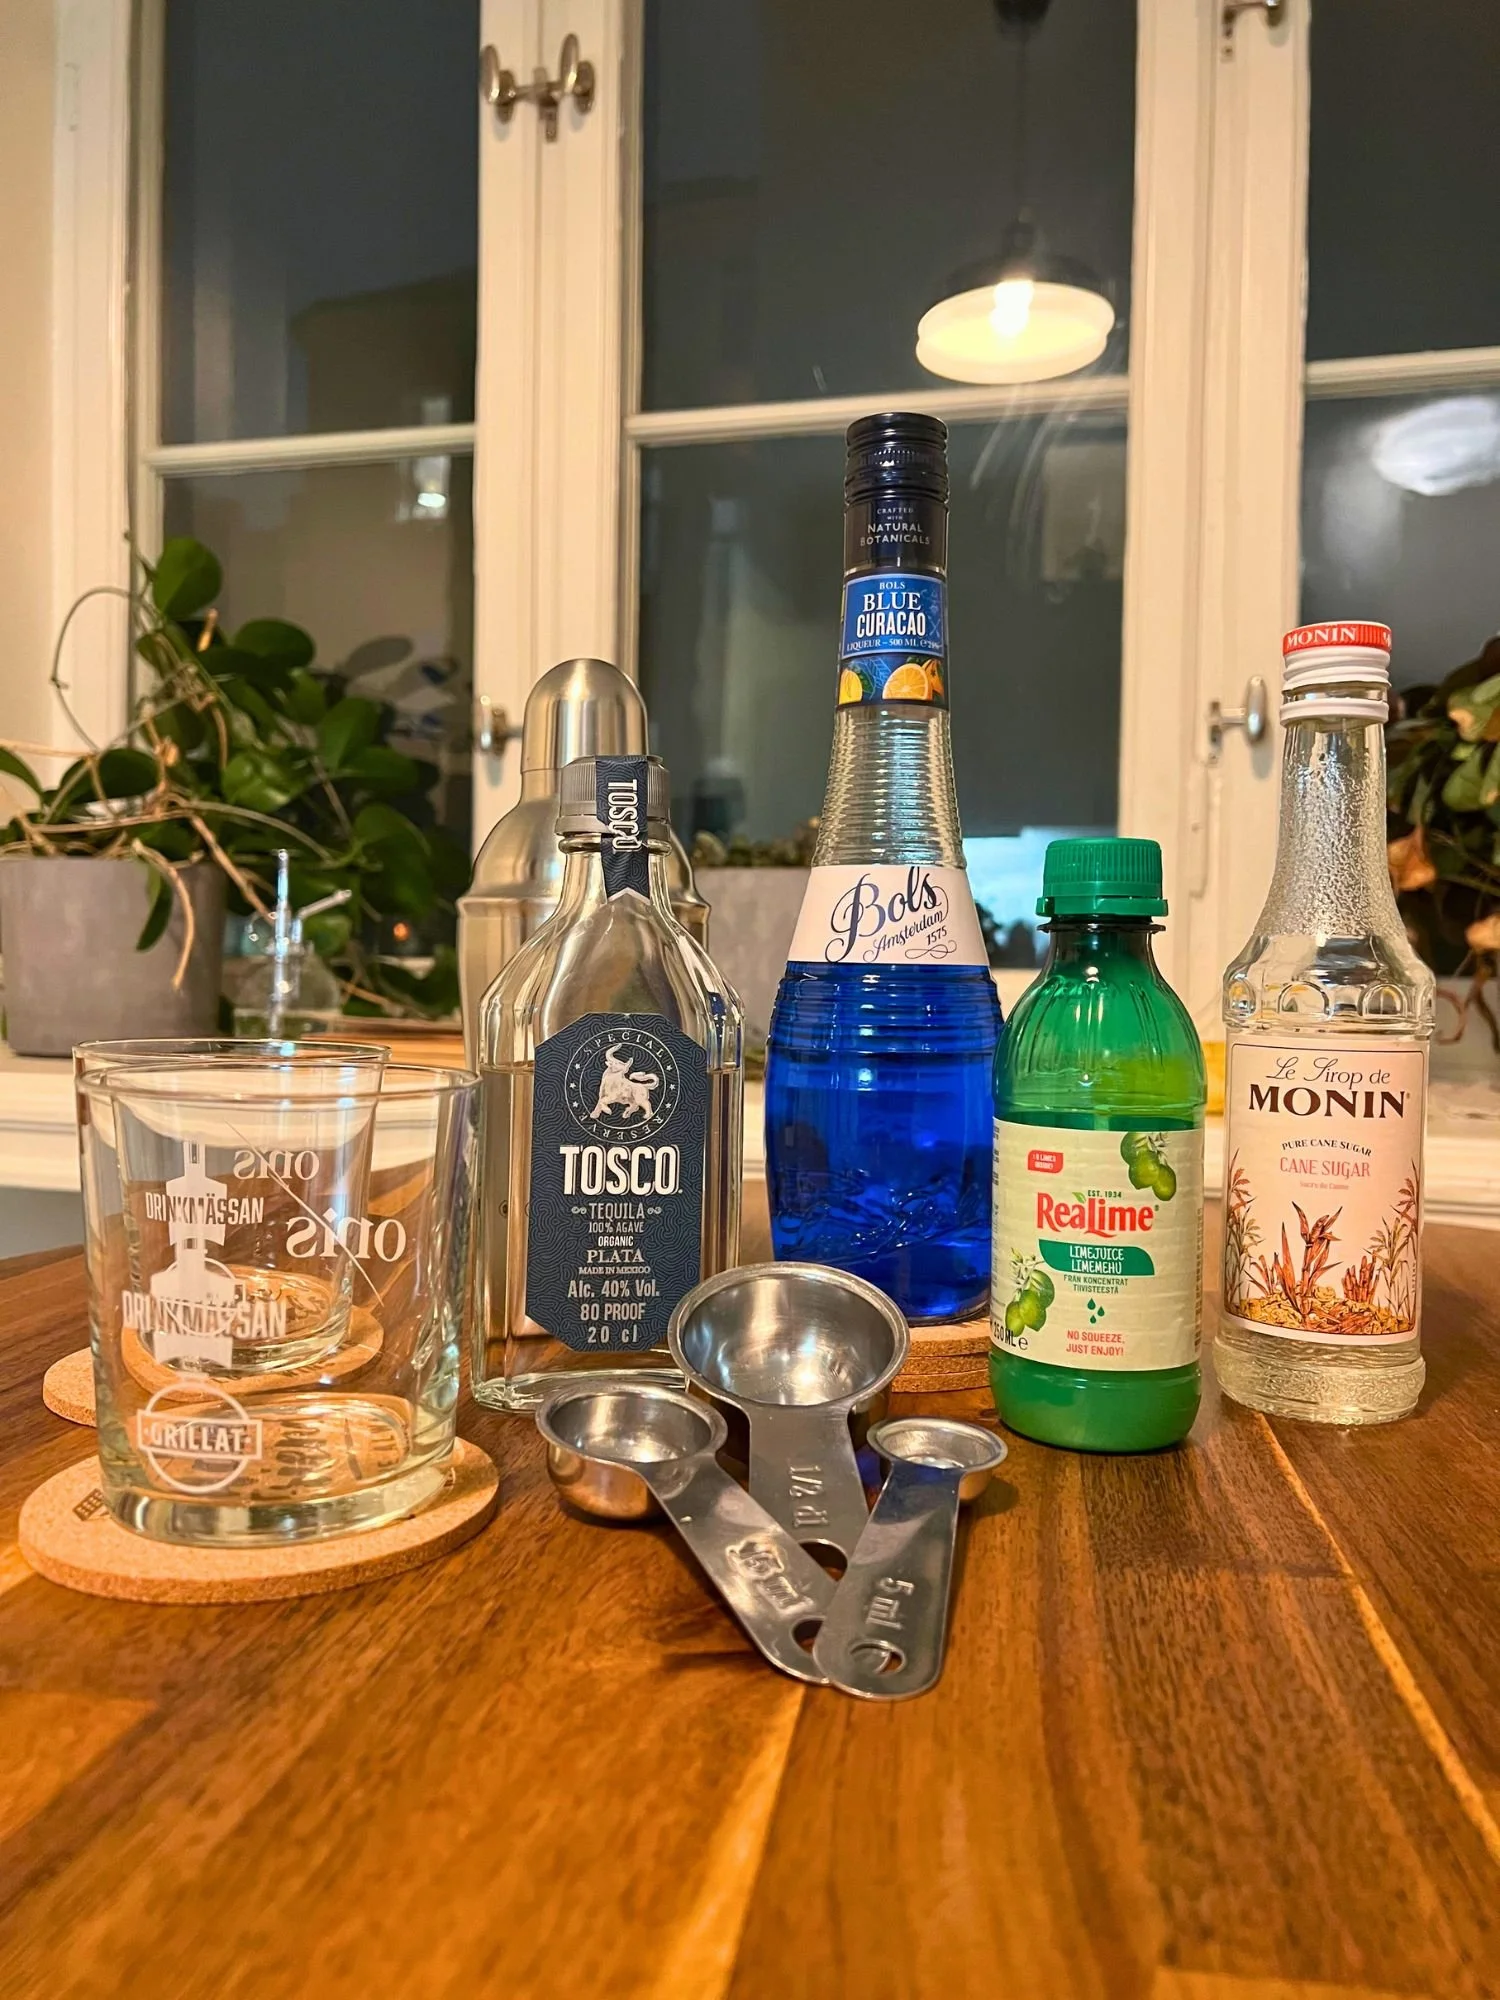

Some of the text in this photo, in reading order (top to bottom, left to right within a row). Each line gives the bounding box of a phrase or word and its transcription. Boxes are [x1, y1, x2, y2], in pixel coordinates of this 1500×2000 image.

[867, 523, 922, 533] NATURAL
[860, 534, 930, 546] BOTANICALS
[880, 581, 906, 590] BOLS
[863, 591, 922, 612] BLUE
[856, 611, 926, 638] CURACAO
[847, 639, 881, 652] LIQUEUR
[1287, 626, 1357, 646] MONIN
[607, 779, 643, 854] TOSCO
[825, 866, 949, 963] Bols
[863, 909, 943, 963] Amsterdam
[926, 925, 948, 946] 1575
[583, 1031, 666, 1058] SPECIAL
[1266, 1056, 1391, 1090] Le Sirop de
[1249, 1083, 1406, 1119] MONIN
[1282, 1139, 1373, 1157] PURE CANE SUGAR
[1280, 1157, 1371, 1179] CANE SUGAR
[1087, 1190, 1122, 1198] EST. 1934
[145, 1192, 264, 1225] DRINKMÄSSAN
[589, 1203, 645, 1222] TEQUILA
[589, 1222, 644, 1233] 100% AGAVE
[598, 1236, 634, 1247] ORGANIC
[586, 1249, 645, 1264] PLATA
[1069, 1245, 1125, 1261] LIMEJUICE
[579, 1265, 651, 1275] MADE IN MEXICO
[1071, 1259, 1122, 1275] LIMEMEHU
[567, 1279, 660, 1299] Alc. 40% Vol.
[1083, 1277, 1128, 1287] KONCENTRAT
[580, 1302, 646, 1321] 80 PROOF
[587, 1324, 638, 1343] 20 cl
[1067, 1330, 1080, 1341] NO
[1066, 1344, 1124, 1357] JUST ENJOY!
[789, 1464, 823, 1497] 1/2
[865, 1576, 914, 1630] 5 ml
